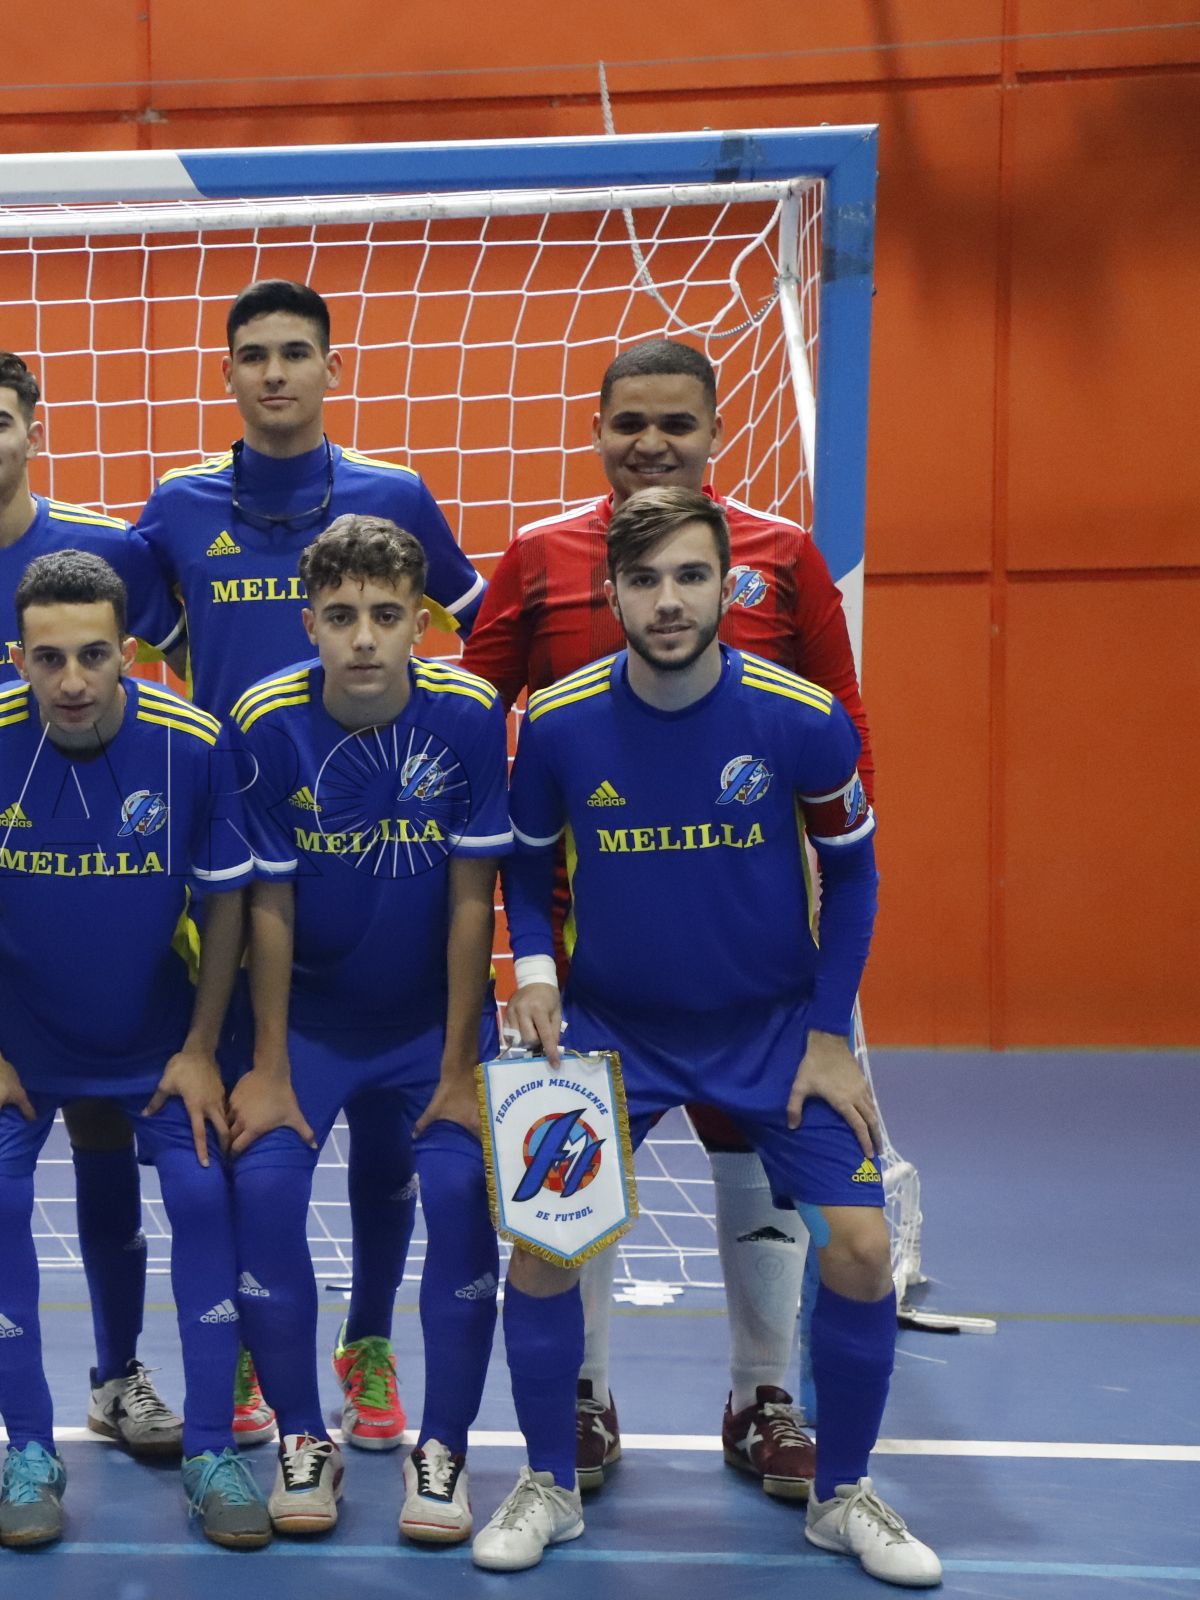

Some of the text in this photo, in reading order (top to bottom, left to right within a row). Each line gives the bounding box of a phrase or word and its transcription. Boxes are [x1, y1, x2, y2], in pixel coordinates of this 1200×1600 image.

[206, 546, 241, 557] adidas
[211, 577, 309, 603] MELI
[587, 797, 626, 807] adidas
[597, 823, 766, 853] MELILLA
[495, 1078, 609, 1125] FEDERACION MELILLENSE
[852, 1172, 881, 1183] adida
[535, 1206, 593, 1222] DE FUTBOL
